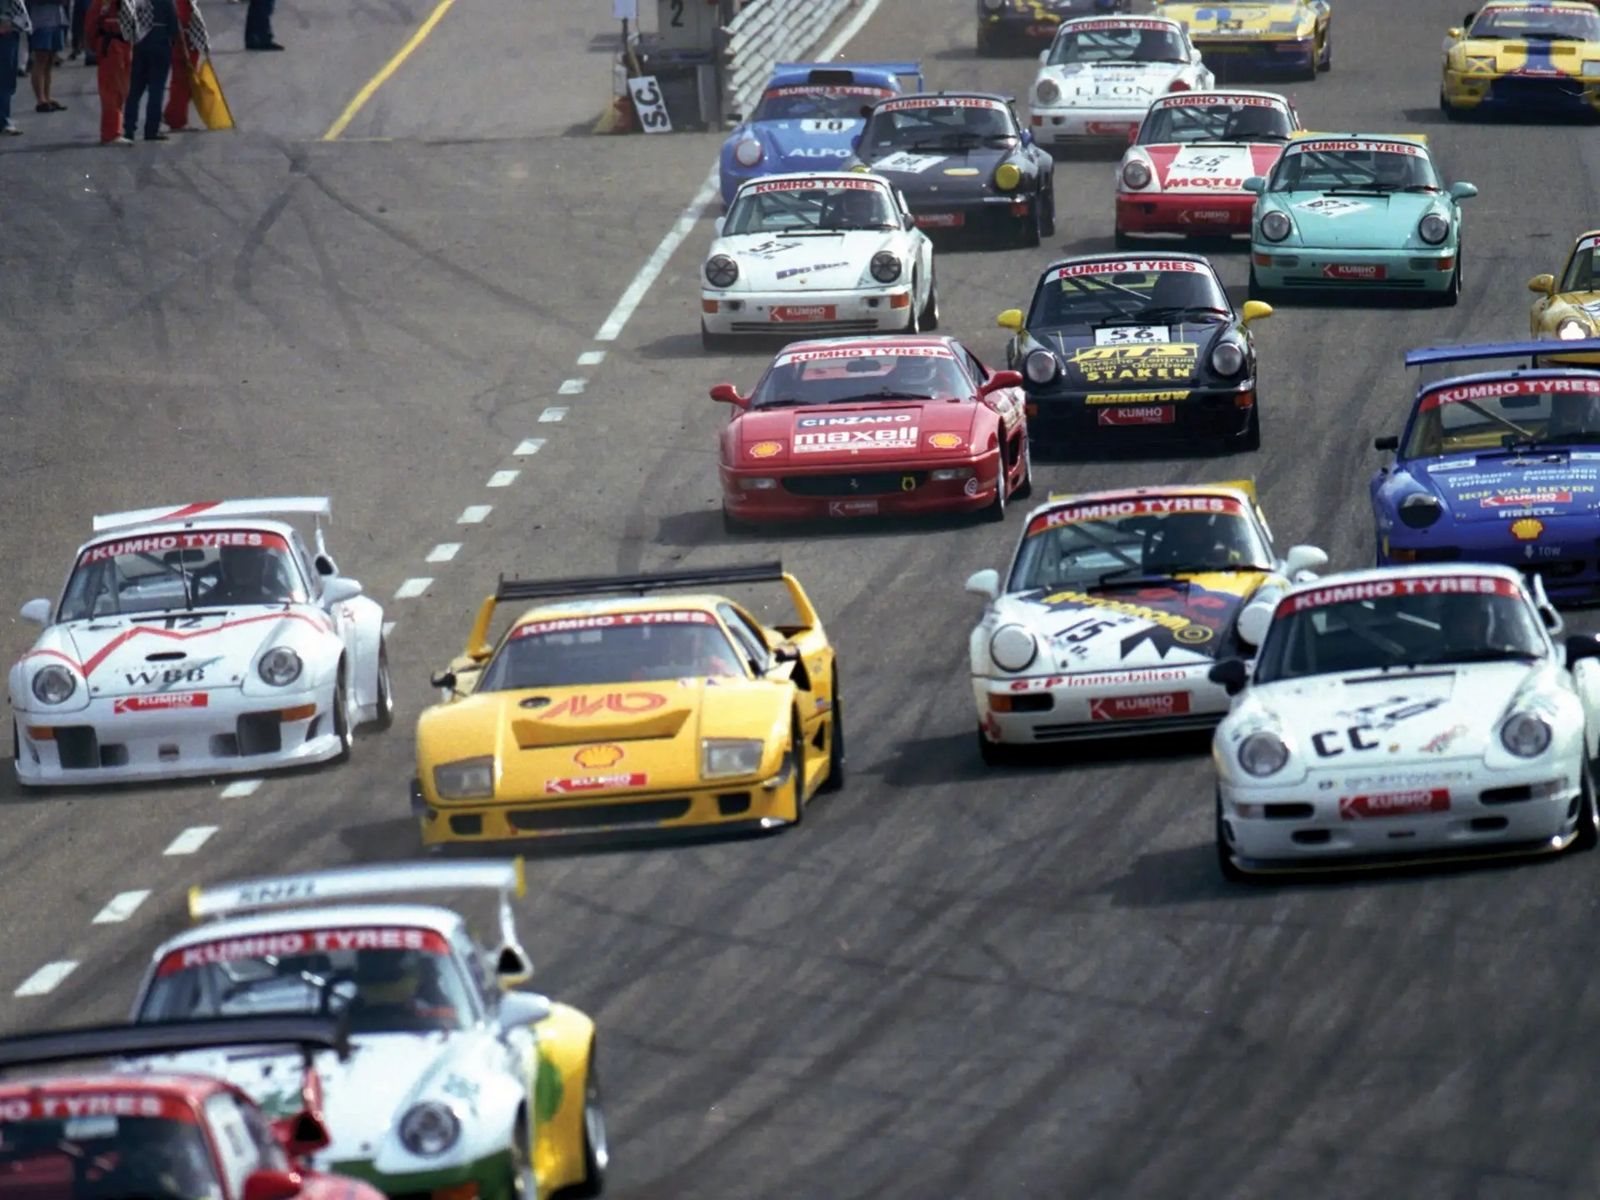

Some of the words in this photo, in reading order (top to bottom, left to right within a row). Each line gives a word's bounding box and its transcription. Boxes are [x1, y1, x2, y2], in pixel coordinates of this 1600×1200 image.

[670, 0, 685, 27] 2
[884, 99, 939, 111] KUMHO
[1163, 97, 1218, 107] KUMHO
[1222, 96, 1273, 107] TYRES
[1301, 142, 1360, 152] KUMHO
[1365, 143, 1417, 154] TYRES
[755, 180, 816, 192] KUMHO
[821, 179, 876, 190] TYRES
[1164, 177, 1242, 189] MOTU
[1193, 210, 1230, 219] KUMHO
[1058, 261, 1127, 278] KUMHO
[1132, 261, 1196, 272] TYRES
[1338, 265, 1376, 274] KUMHO
[786, 307, 826, 316] KUMHO
[1110, 329, 1155, 341] 56
[790, 349, 863, 362] KUMHO
[870, 348, 934, 357] TYRES
[1086, 368, 1190, 381] STAKEN
[1437, 382, 1520, 405] KUMHO
[1525, 379, 1600, 393] TYRES
[1117, 407, 1163, 418] KUMHO
[802, 414, 912, 427] CINZANO
[794, 427, 919, 445] maxell
[1497, 486, 1531, 494] VAN
[1503, 493, 1557, 502] KUMHO
[1047, 502, 1135, 527] KUMHO
[1142, 498, 1225, 512] TYRES
[92, 535, 177, 561] KUMHO
[182, 532, 263, 547] TYRES
[1538, 546, 1561, 556] TOW
[1294, 580, 1396, 610] KUMHO
[1401, 577, 1496, 594] TYRES
[521, 616, 615, 636] KUMHO
[622, 611, 707, 624] TYRES
[137, 694, 194, 705] KUMHO
[1114, 695, 1174, 711] KUMHO
[1366, 790, 1433, 809] KUMHO
[183, 932, 305, 967] KUMHO
[313, 929, 424, 949] TYRES
[42, 1096, 163, 1118] TYRES
